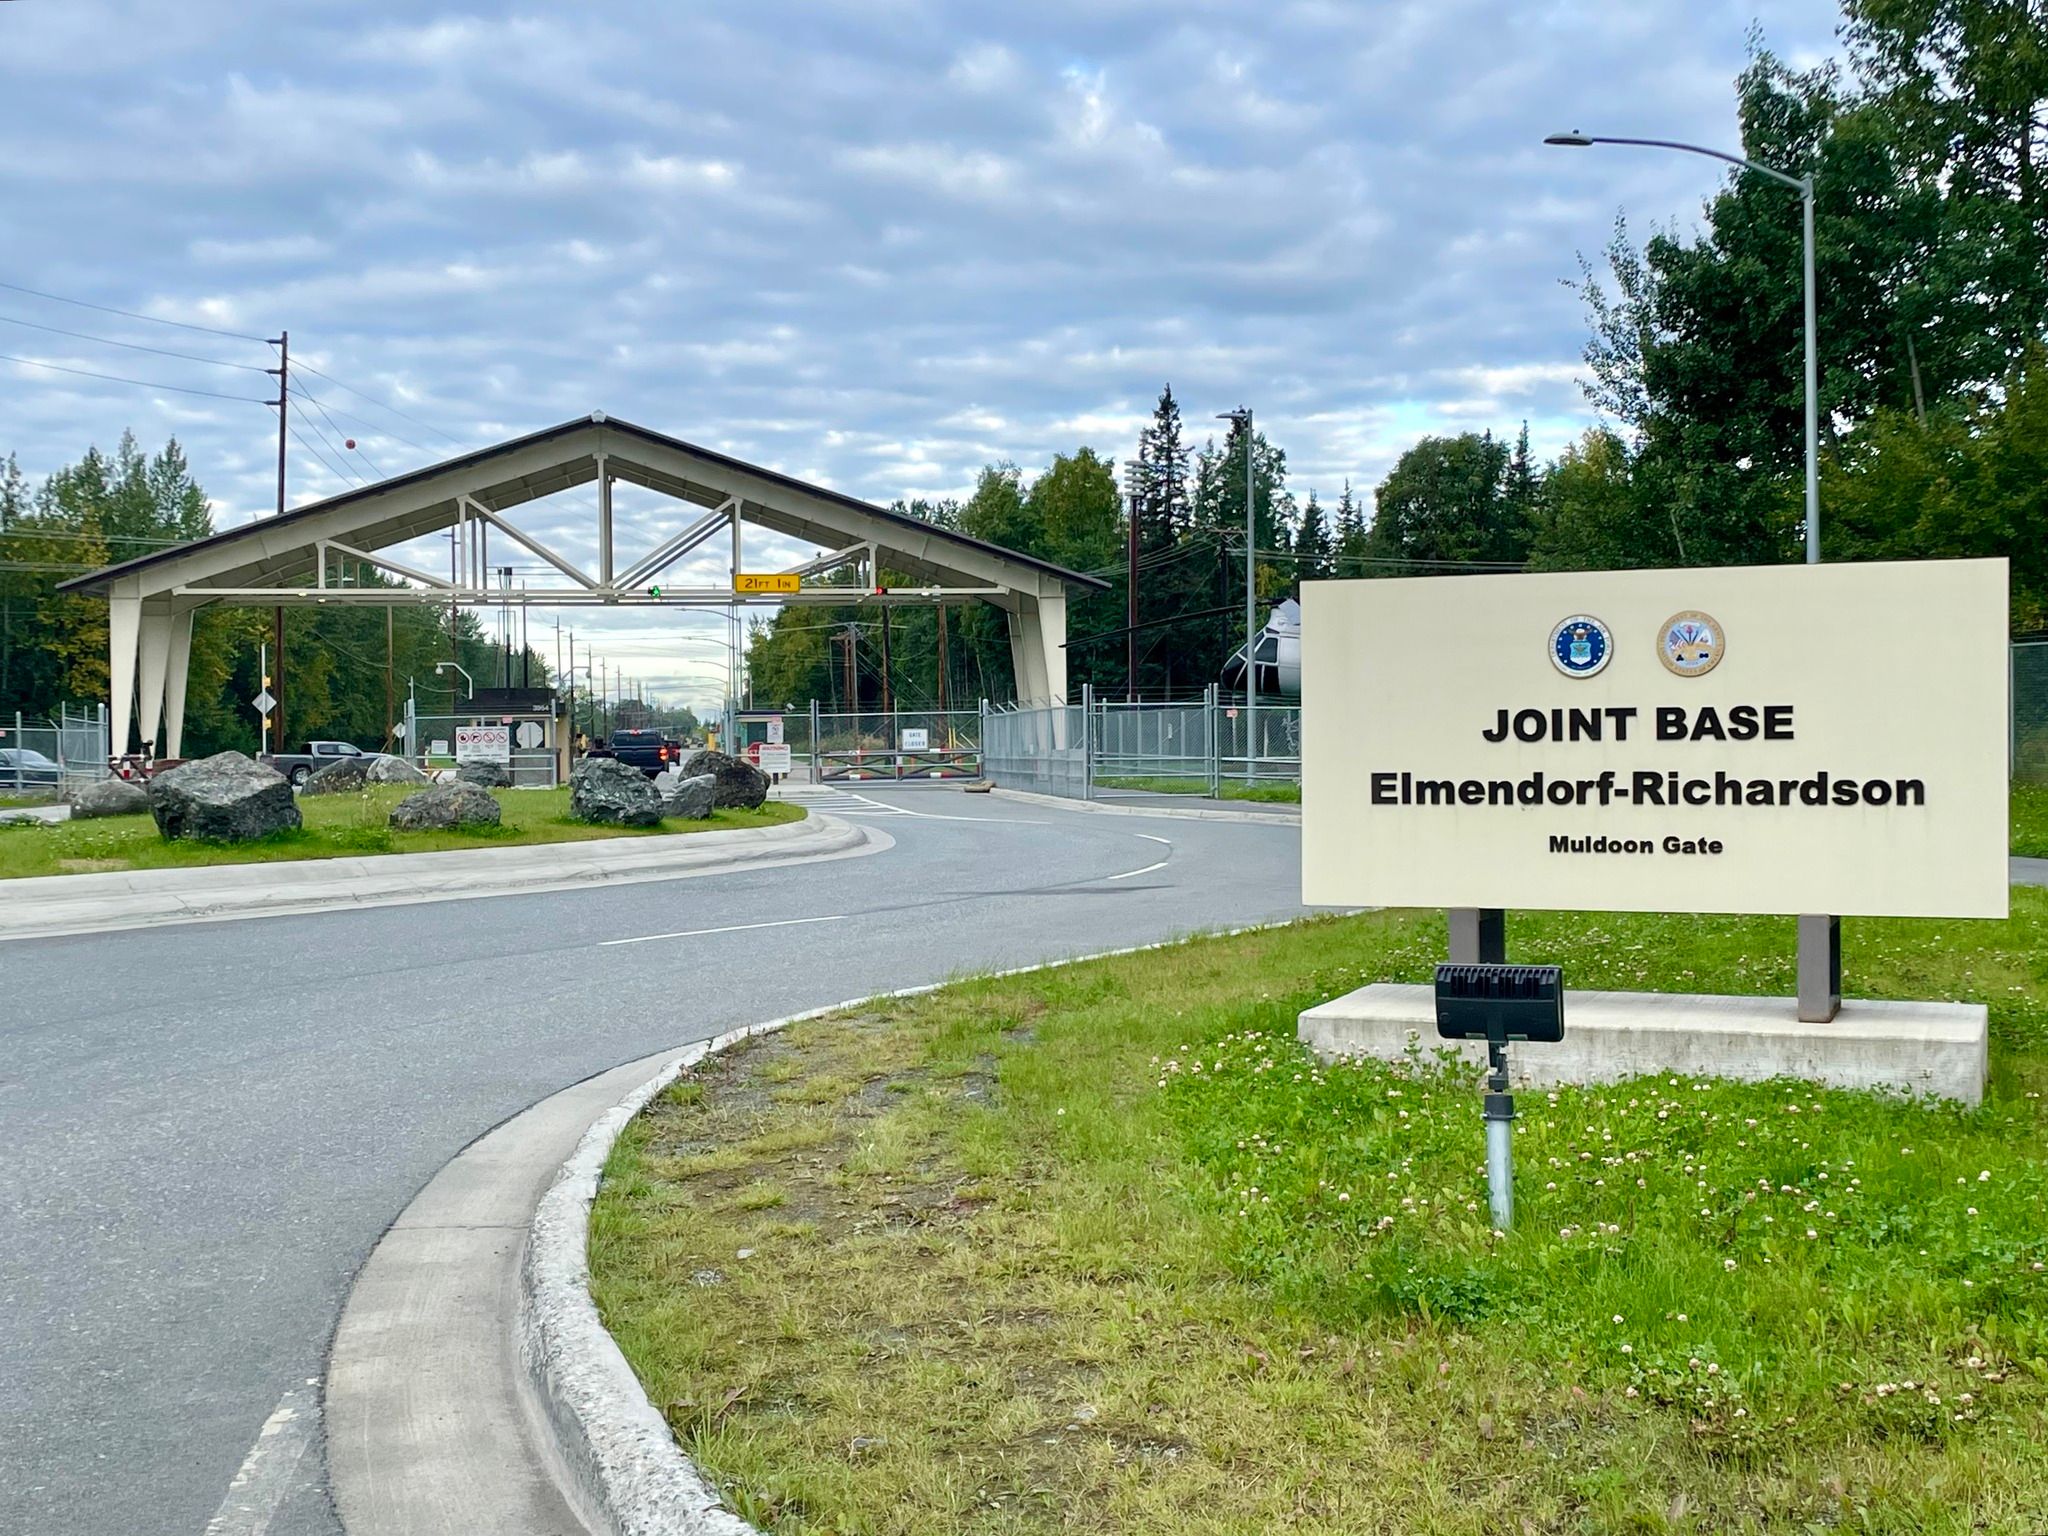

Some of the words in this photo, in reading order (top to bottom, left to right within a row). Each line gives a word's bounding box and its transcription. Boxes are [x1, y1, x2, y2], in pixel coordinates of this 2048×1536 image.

[1482, 708, 1637, 743] JOINT
[1656, 705, 1795, 741] BASE
[1371, 771, 1925, 806] Elmendorf-Richardson
[1549, 835, 1654, 855] Muldoon
[1662, 836, 1724, 855] Gate
